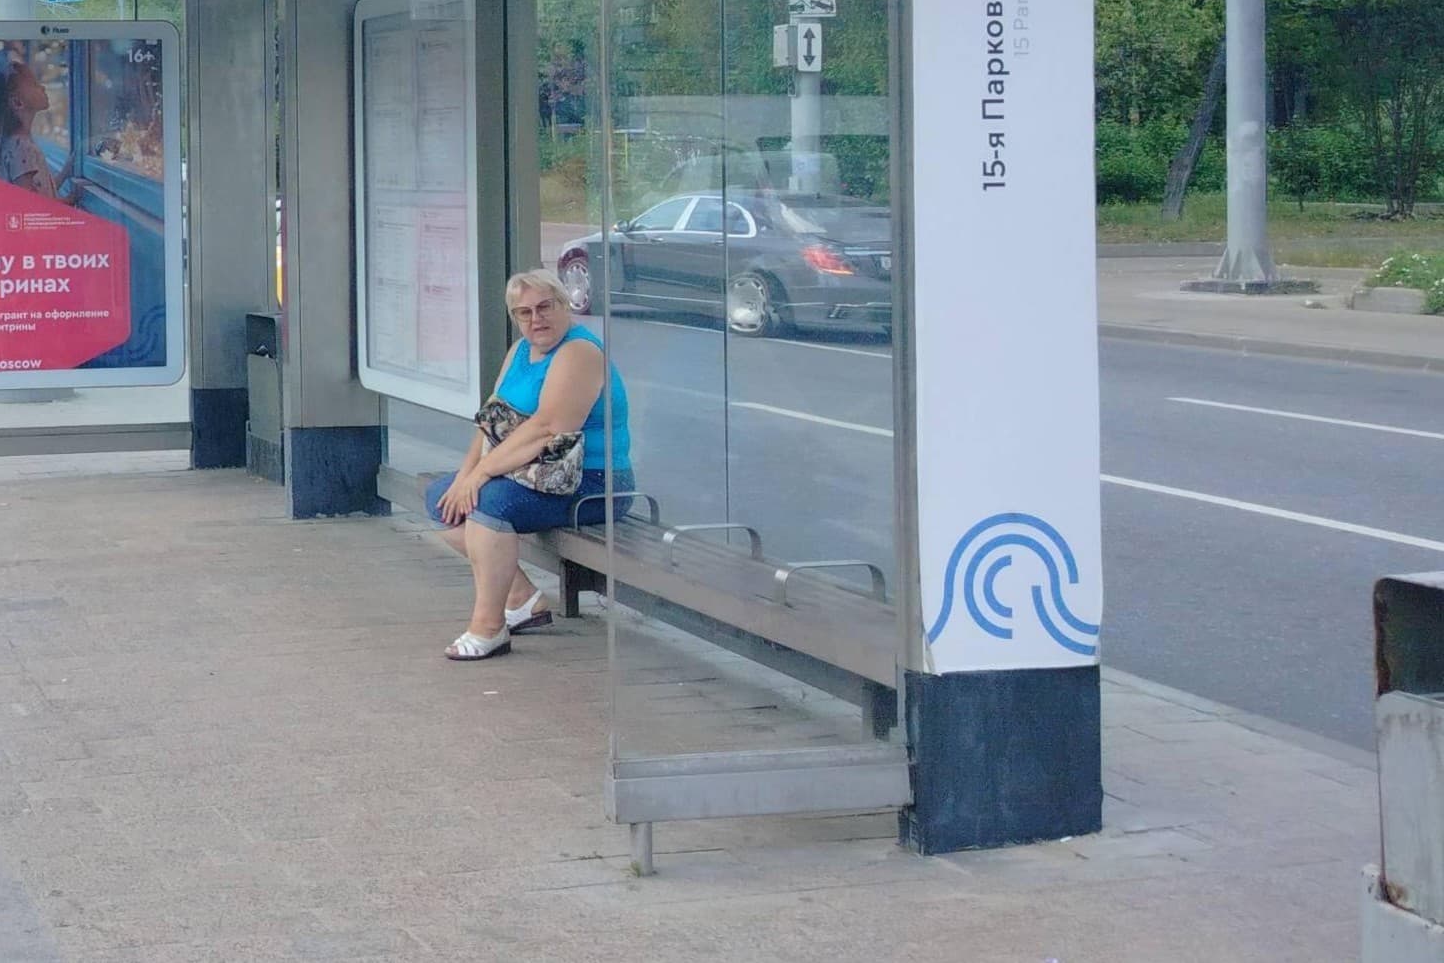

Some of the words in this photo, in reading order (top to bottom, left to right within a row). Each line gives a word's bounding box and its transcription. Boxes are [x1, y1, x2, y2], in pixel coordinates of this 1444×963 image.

[1013, 36, 1030, 59] 15
[127, 49, 155, 63] 16+
[982, 132, 1006, 192] 15-я
[22, 255, 35, 269] в
[42, 254, 109, 269] твоих
[0, 311, 28, 321] грант
[45, 309, 109, 320] оформление
